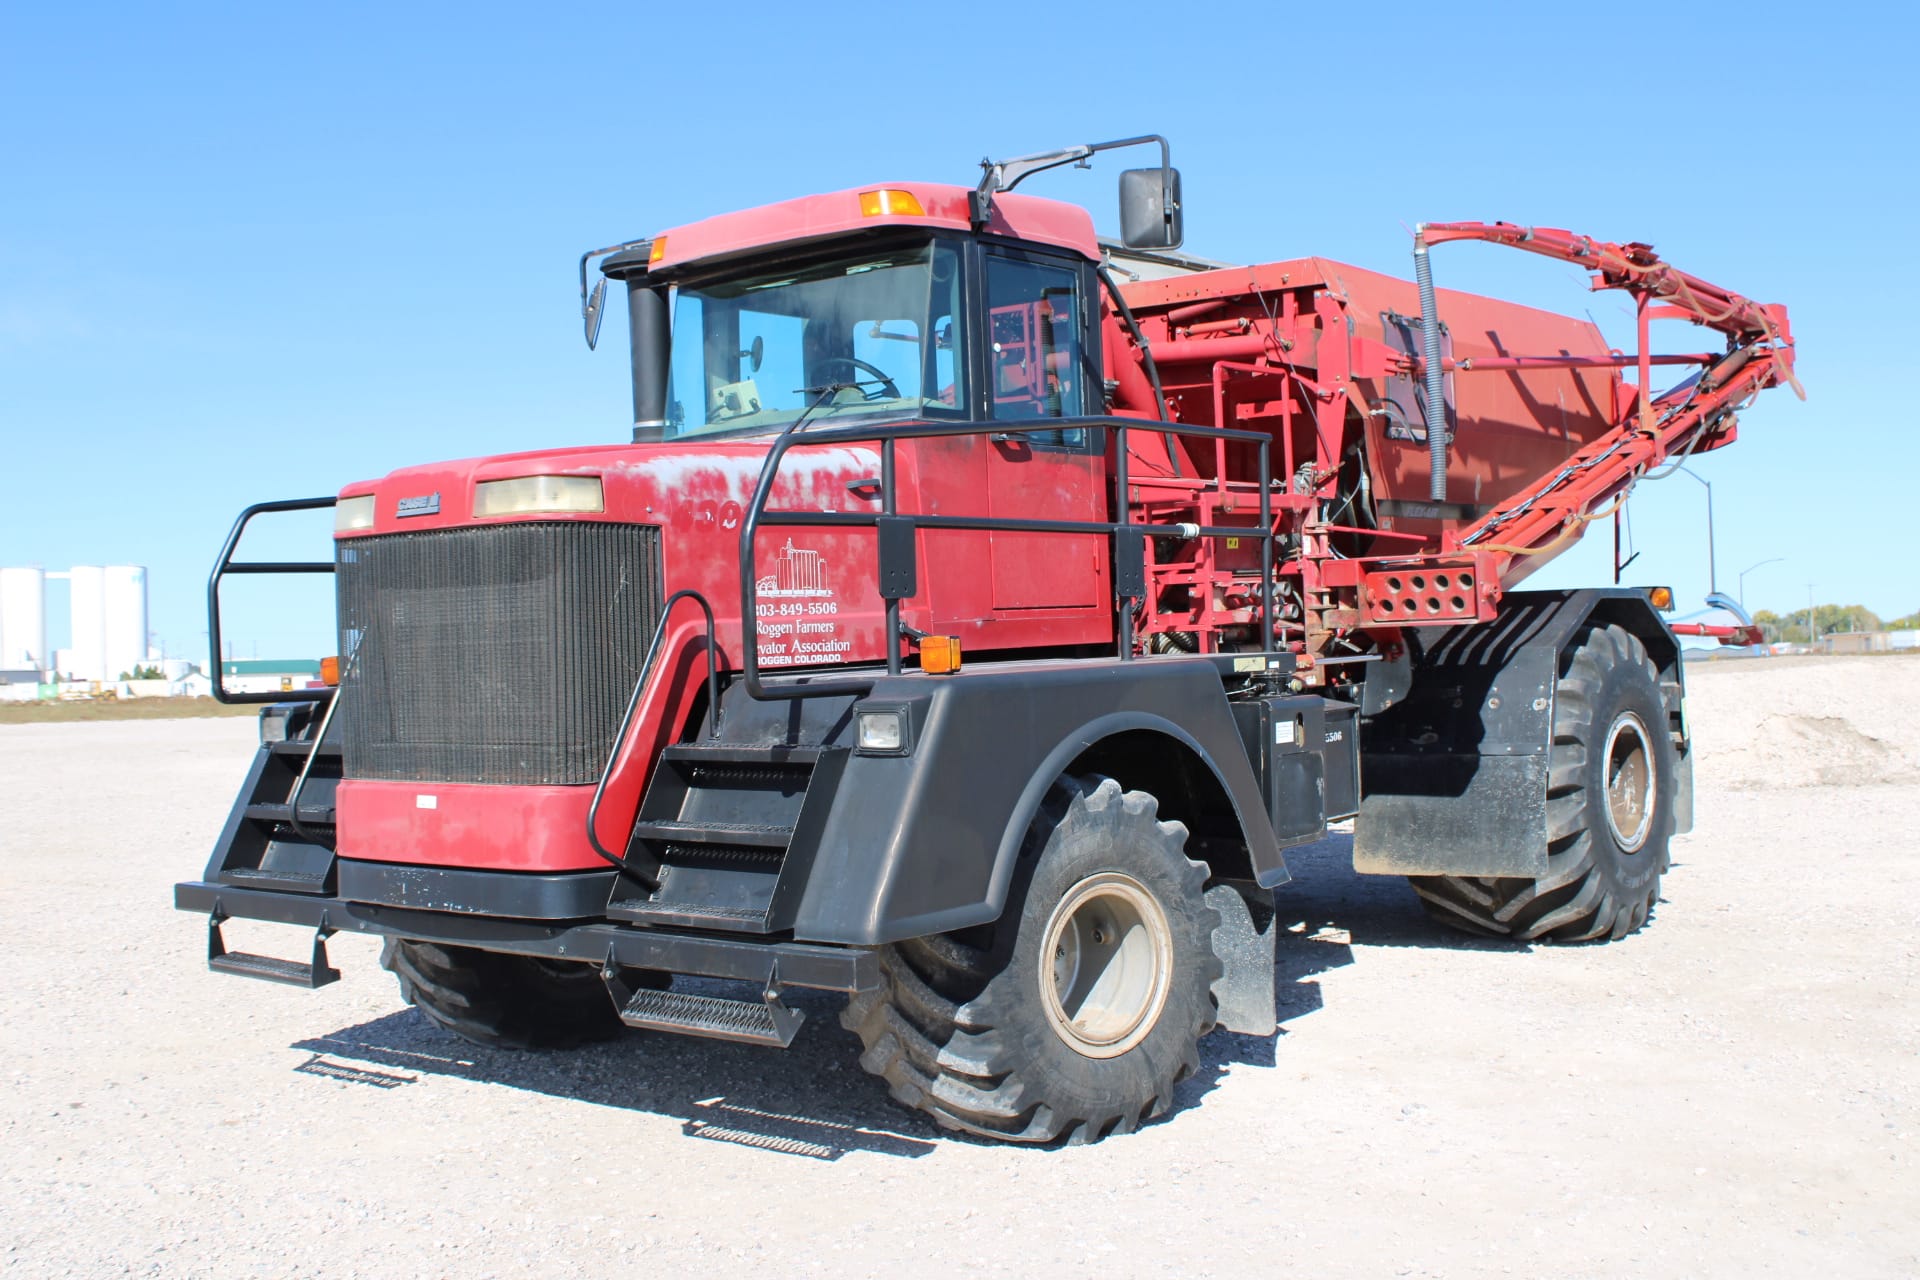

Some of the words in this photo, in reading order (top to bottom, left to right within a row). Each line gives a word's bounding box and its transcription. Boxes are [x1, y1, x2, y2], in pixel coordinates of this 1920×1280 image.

[756, 620, 792, 638] Roggen
[796, 619, 834, 634] Farmers
[757, 642, 786, 655] vator
[791, 639, 850, 653] Association
[794, 653, 841, 664] COLORADO
